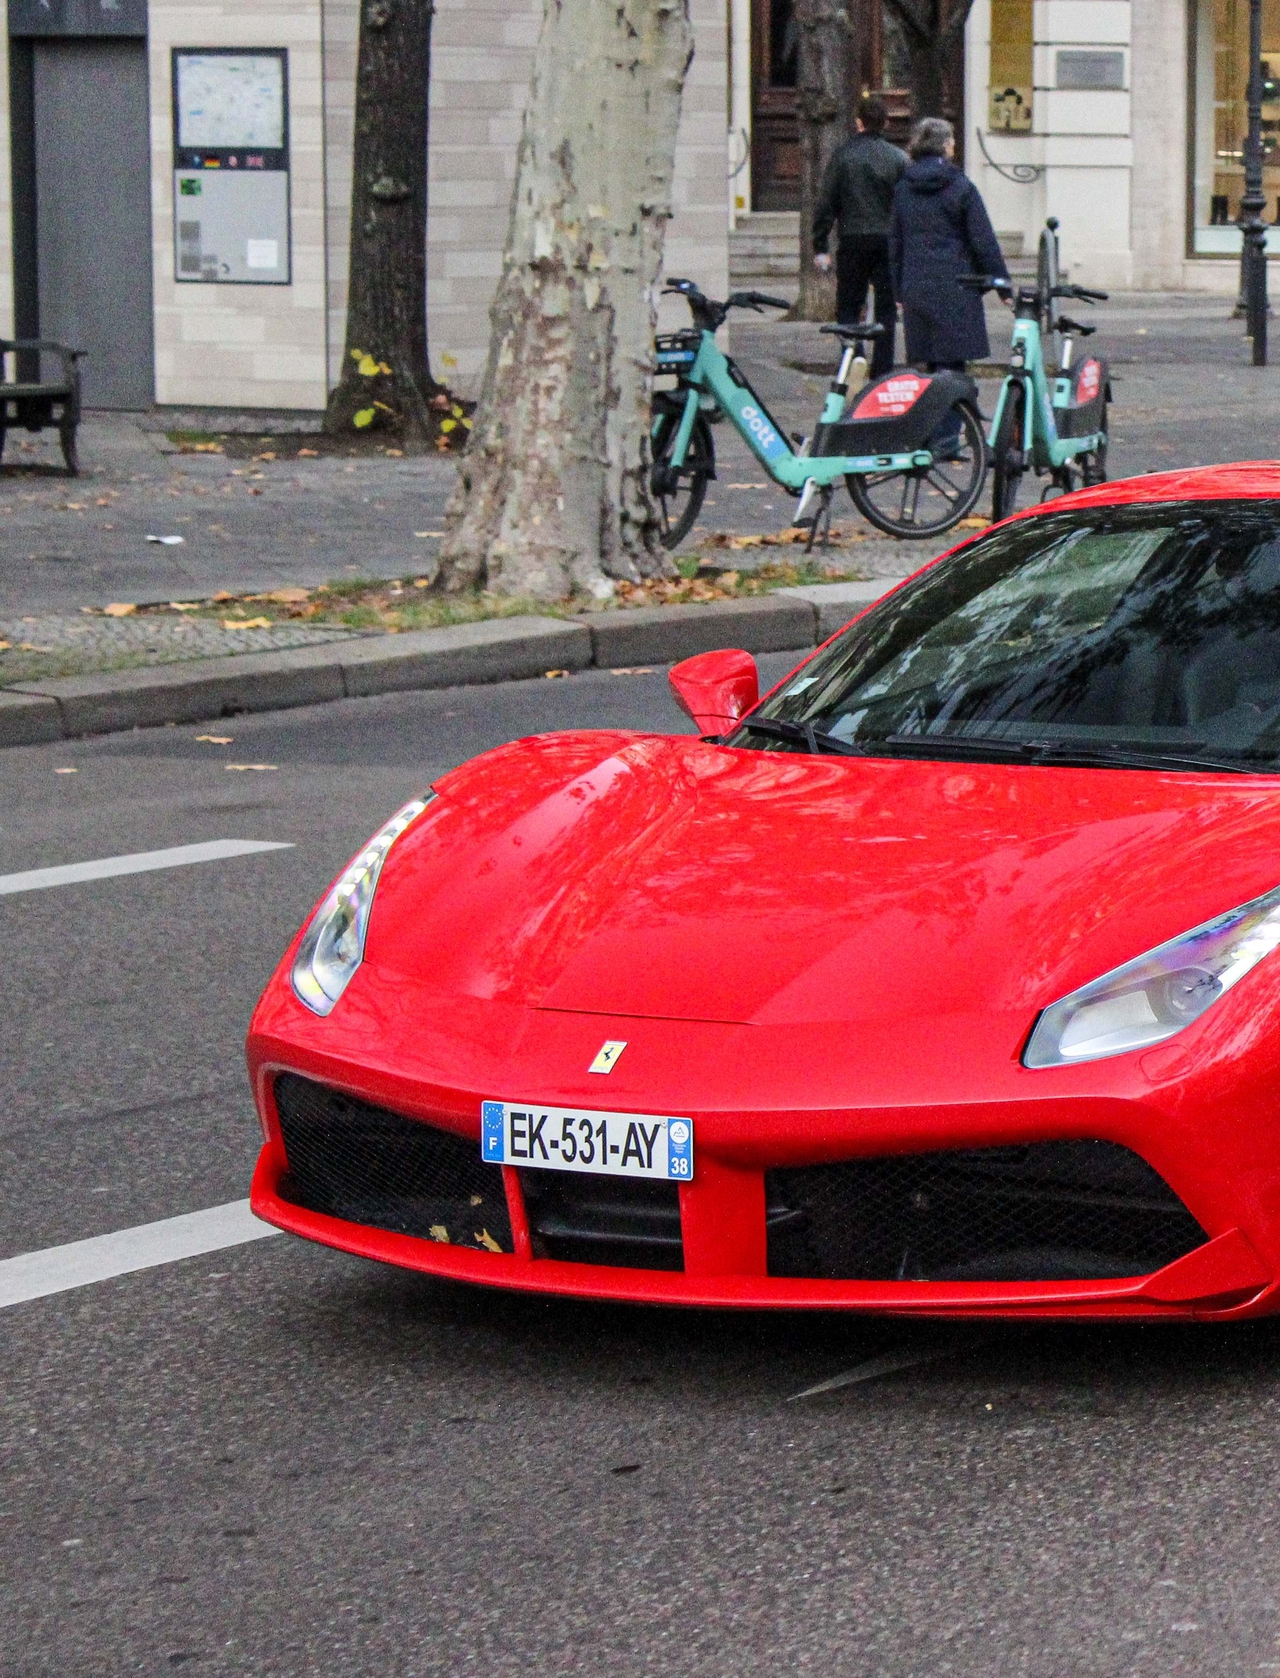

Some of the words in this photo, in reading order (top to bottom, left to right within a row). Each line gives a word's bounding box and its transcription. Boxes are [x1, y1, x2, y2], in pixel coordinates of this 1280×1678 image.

[741, 406, 776, 448] dott
[489, 1136, 498, 1150] F
[510, 1111, 661, 1169] EK-531-AY
[671, 1157, 689, 1175] 38
